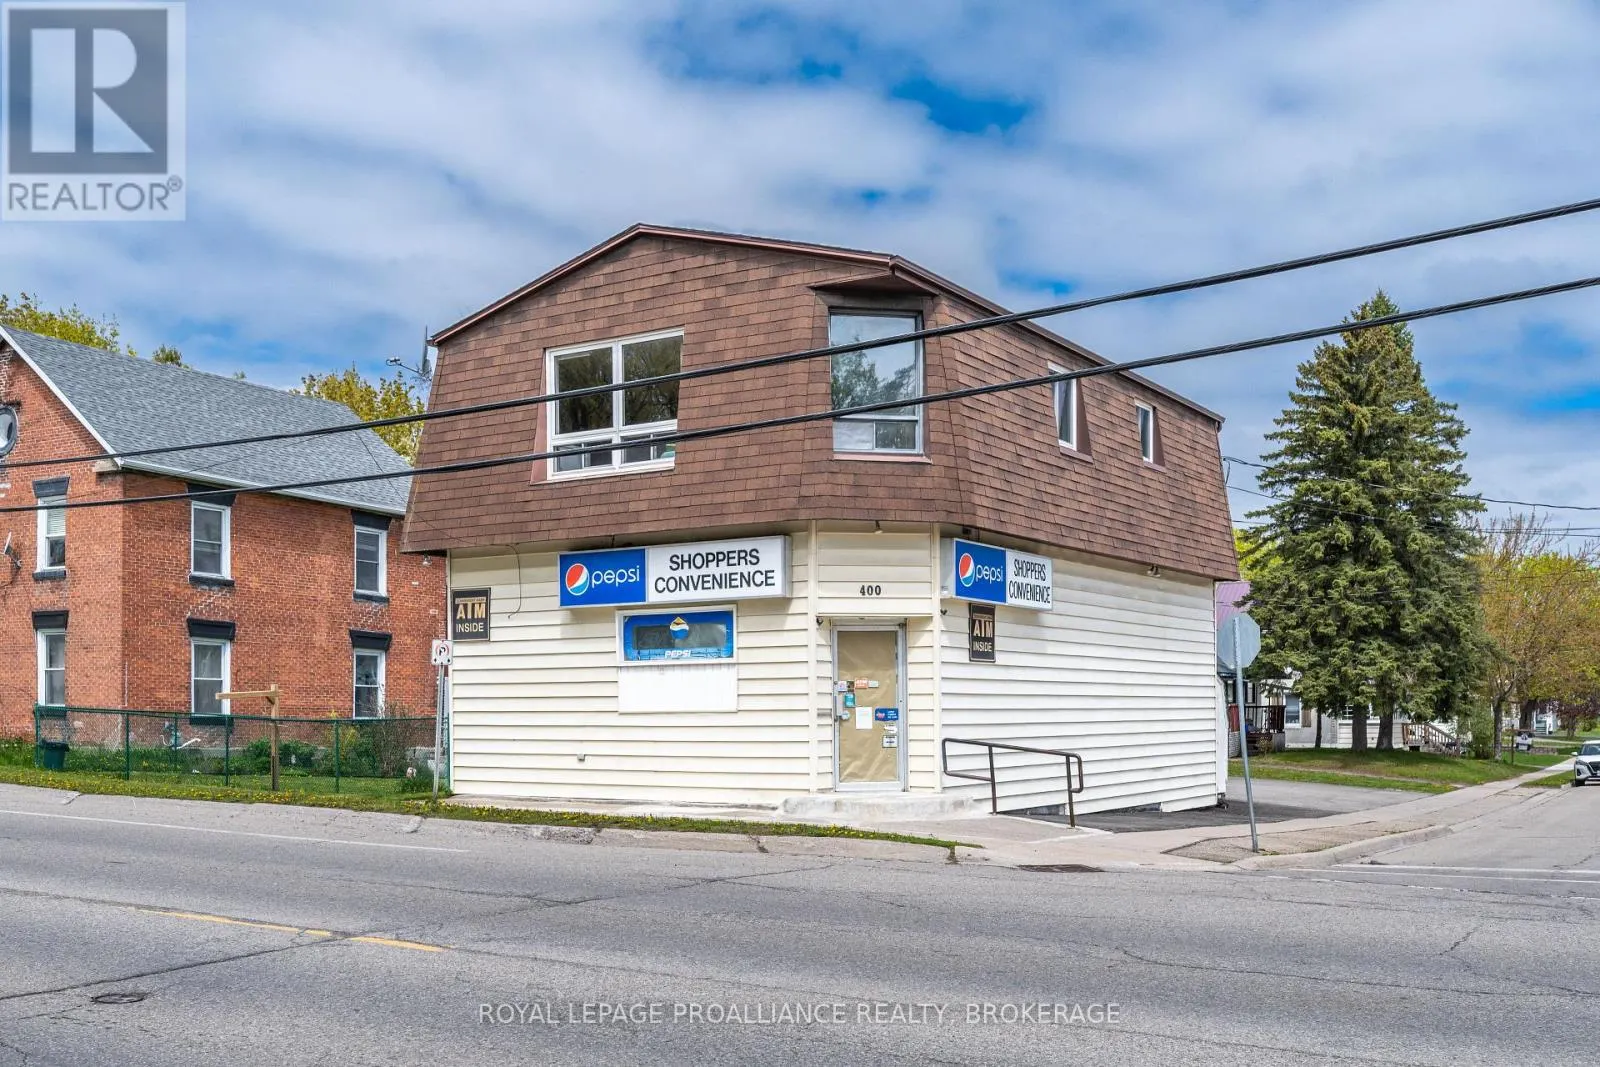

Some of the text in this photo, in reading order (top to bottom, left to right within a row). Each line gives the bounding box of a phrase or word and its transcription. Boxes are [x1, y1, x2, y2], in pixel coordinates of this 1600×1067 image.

[669, 548, 760, 571] SHOPPERS
[591, 565, 640, 589] pepsi
[975, 565, 1004, 585] pepsi
[1013, 559, 1046, 582] SHOPPERS
[654, 570, 776, 594] CONVENIENCE
[859, 584, 882, 596] 400
[1008, 580, 1051, 604] CONVENIENCE
[456, 602, 486, 619] ATM
[456, 622, 484, 633] INSIDE
[973, 619, 993, 638] ATM
[664, 649, 692, 659] PEPSI
[972, 641, 992, 652] INSIDE
